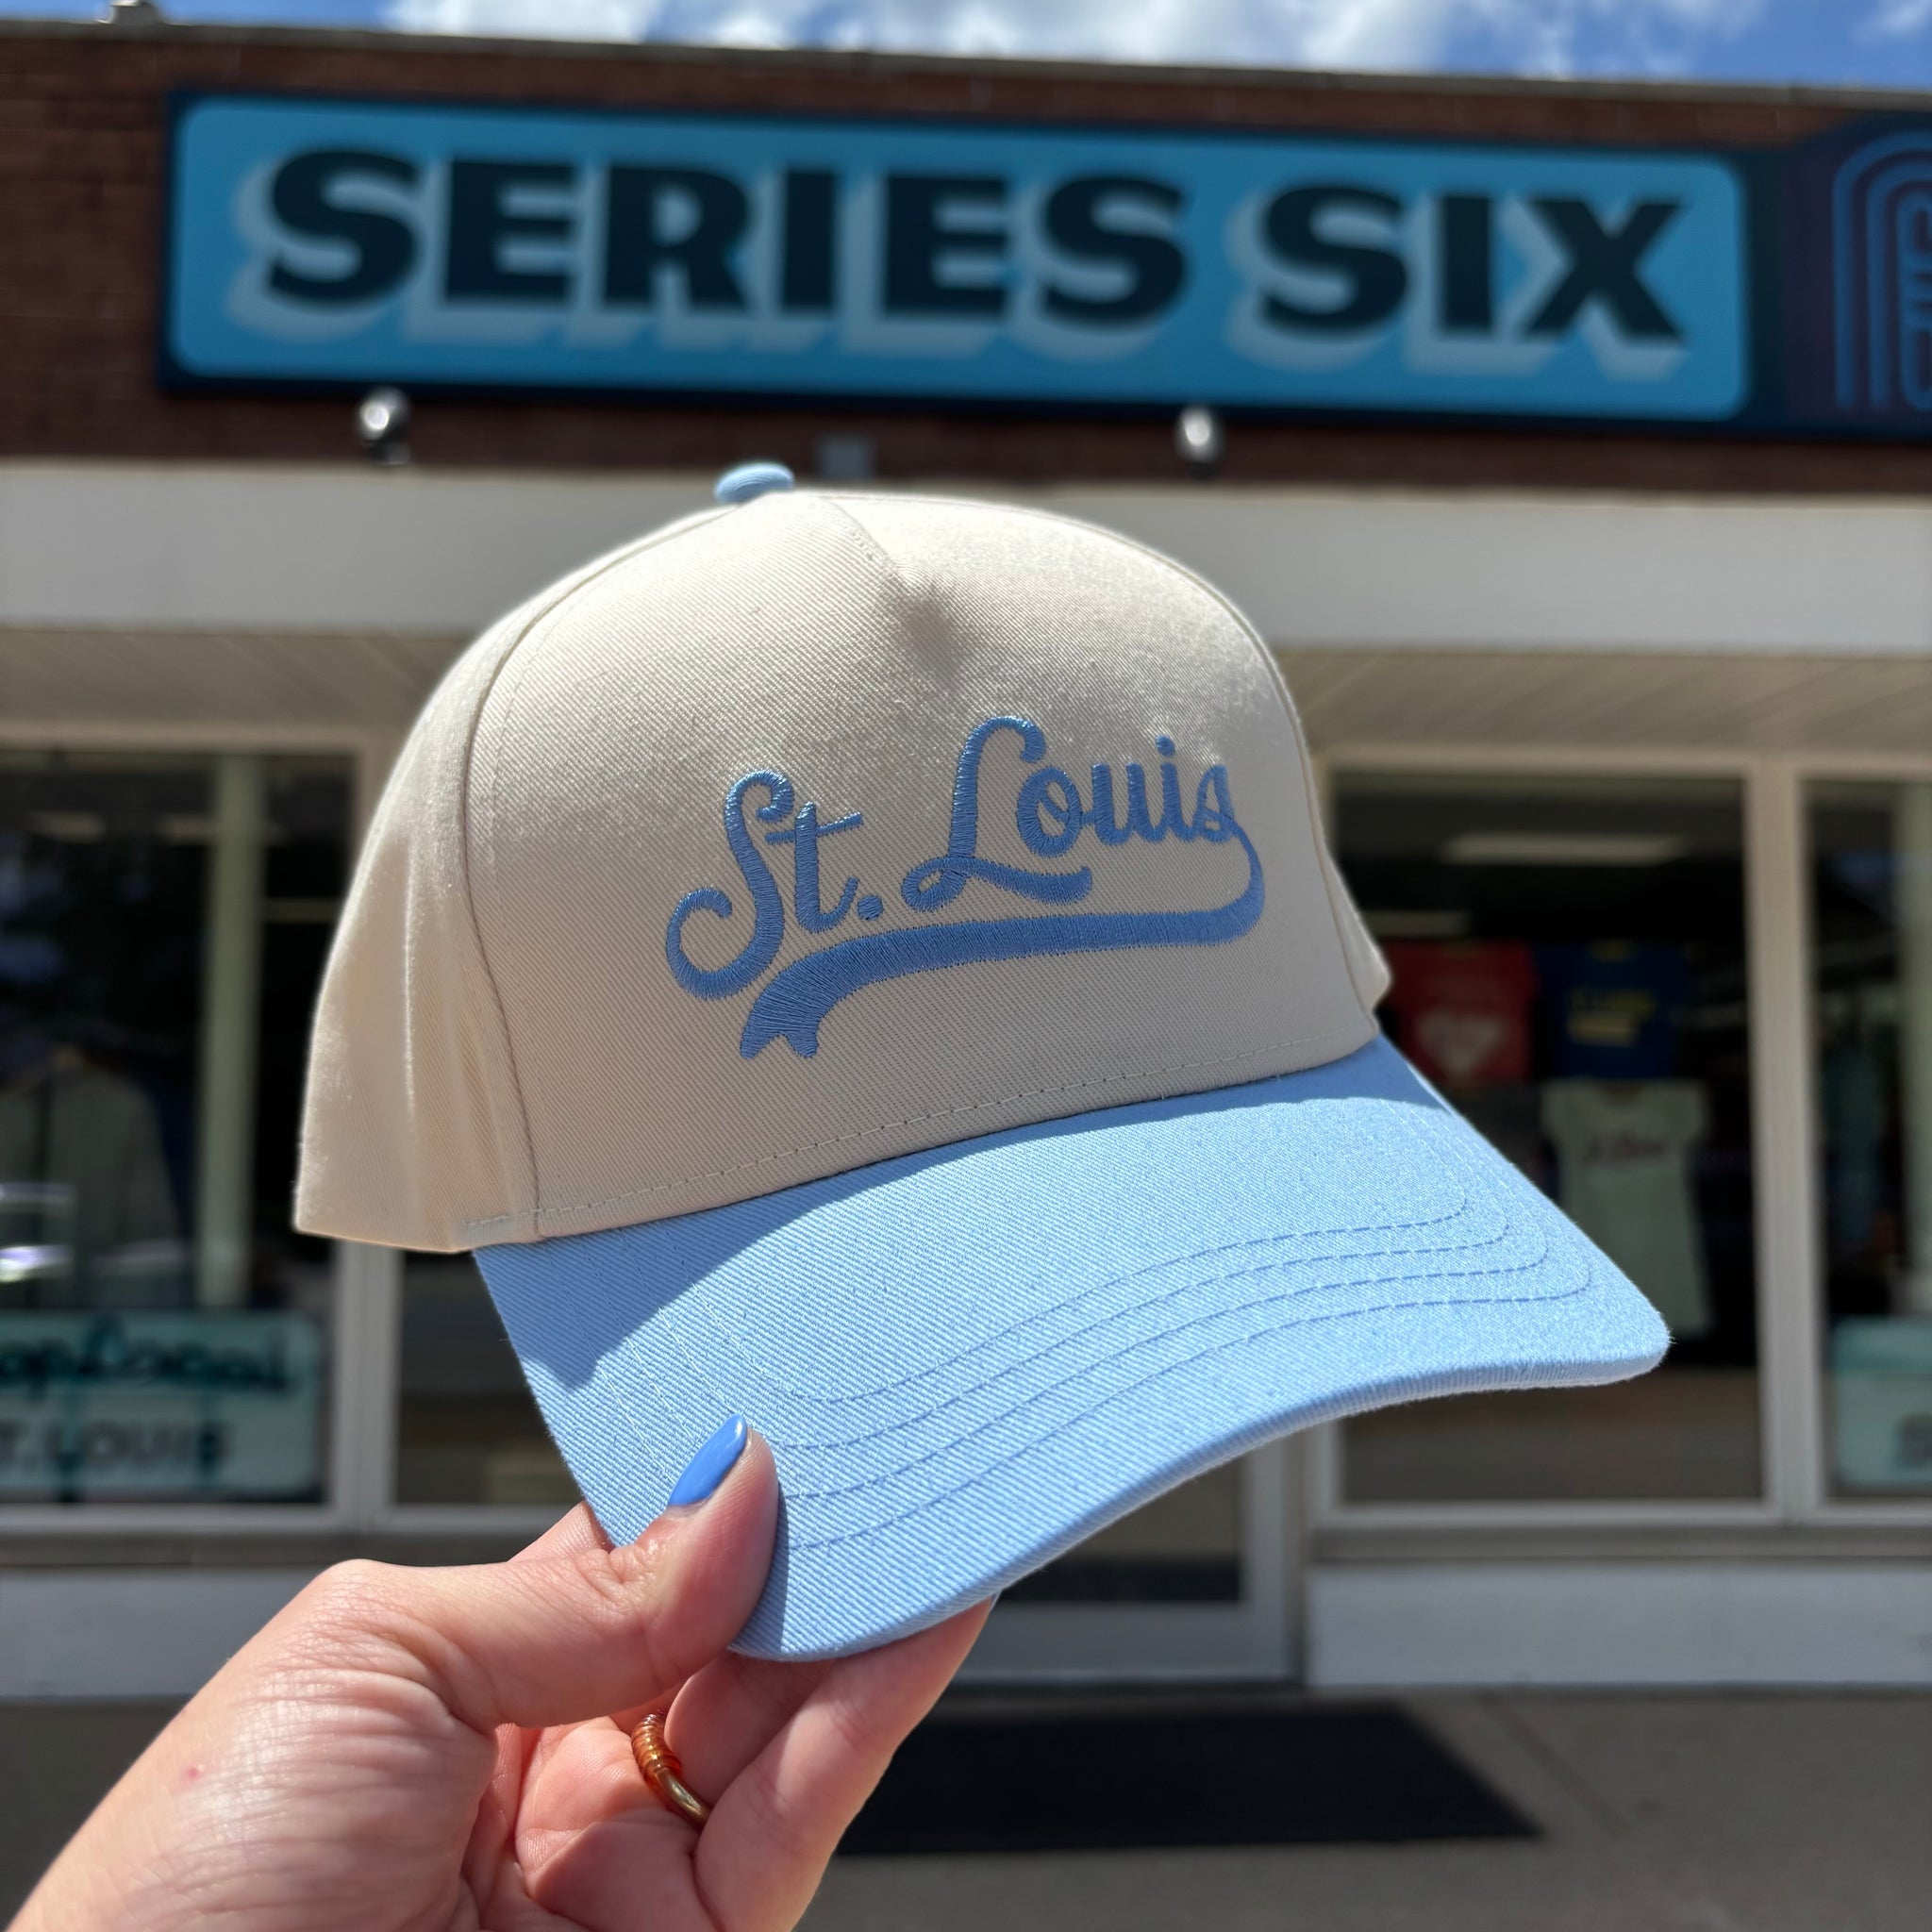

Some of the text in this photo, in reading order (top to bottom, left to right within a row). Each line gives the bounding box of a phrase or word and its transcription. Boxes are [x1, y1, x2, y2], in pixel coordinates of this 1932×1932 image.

[267, 147, 1686, 344] SERIES SIX
[666, 715, 1236, 1002] St. Louis
